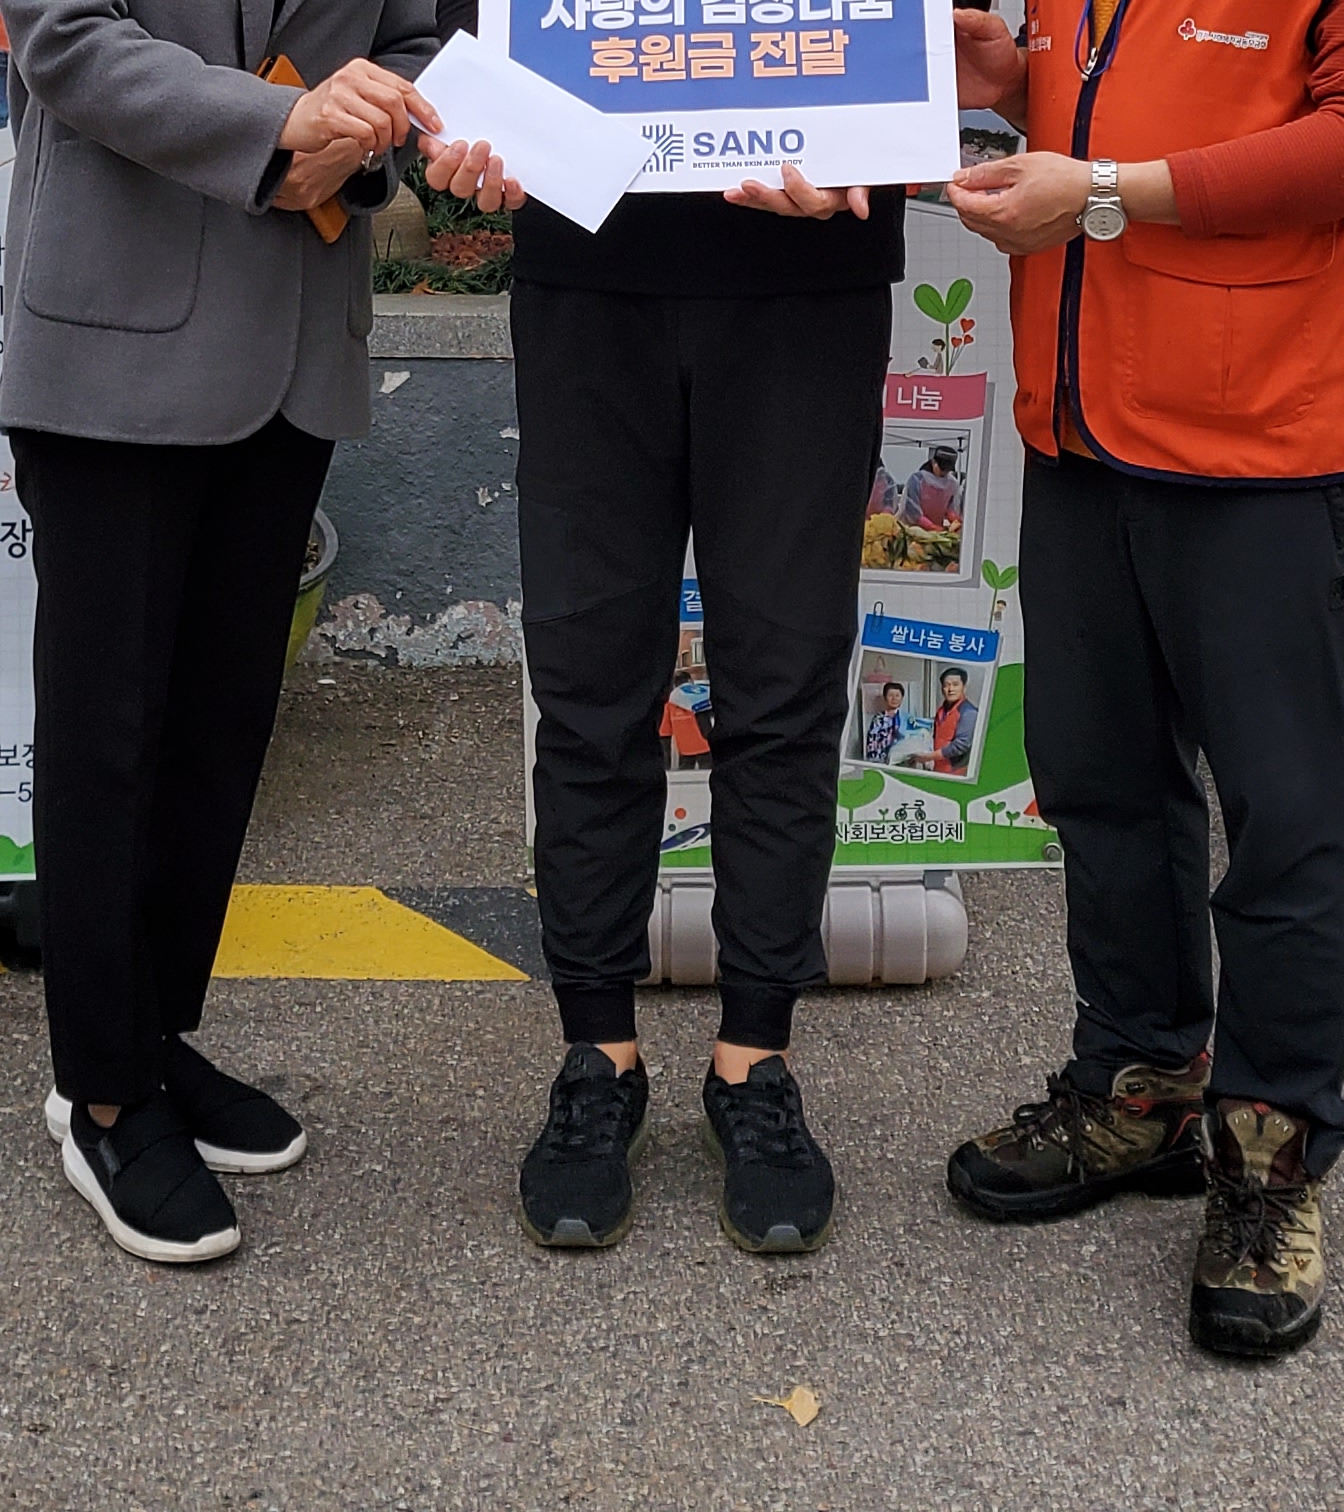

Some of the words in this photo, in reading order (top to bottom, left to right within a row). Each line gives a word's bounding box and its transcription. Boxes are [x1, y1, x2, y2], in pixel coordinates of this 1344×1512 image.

[589, 31, 738, 84] 후원금
[749, 28, 850, 79] 전달
[692, 128, 806, 158] SANO
[896, 384, 943, 412] 나눔
[890, 624, 945, 650] 쌀나눔
[948, 633, 985, 656] 봉사
